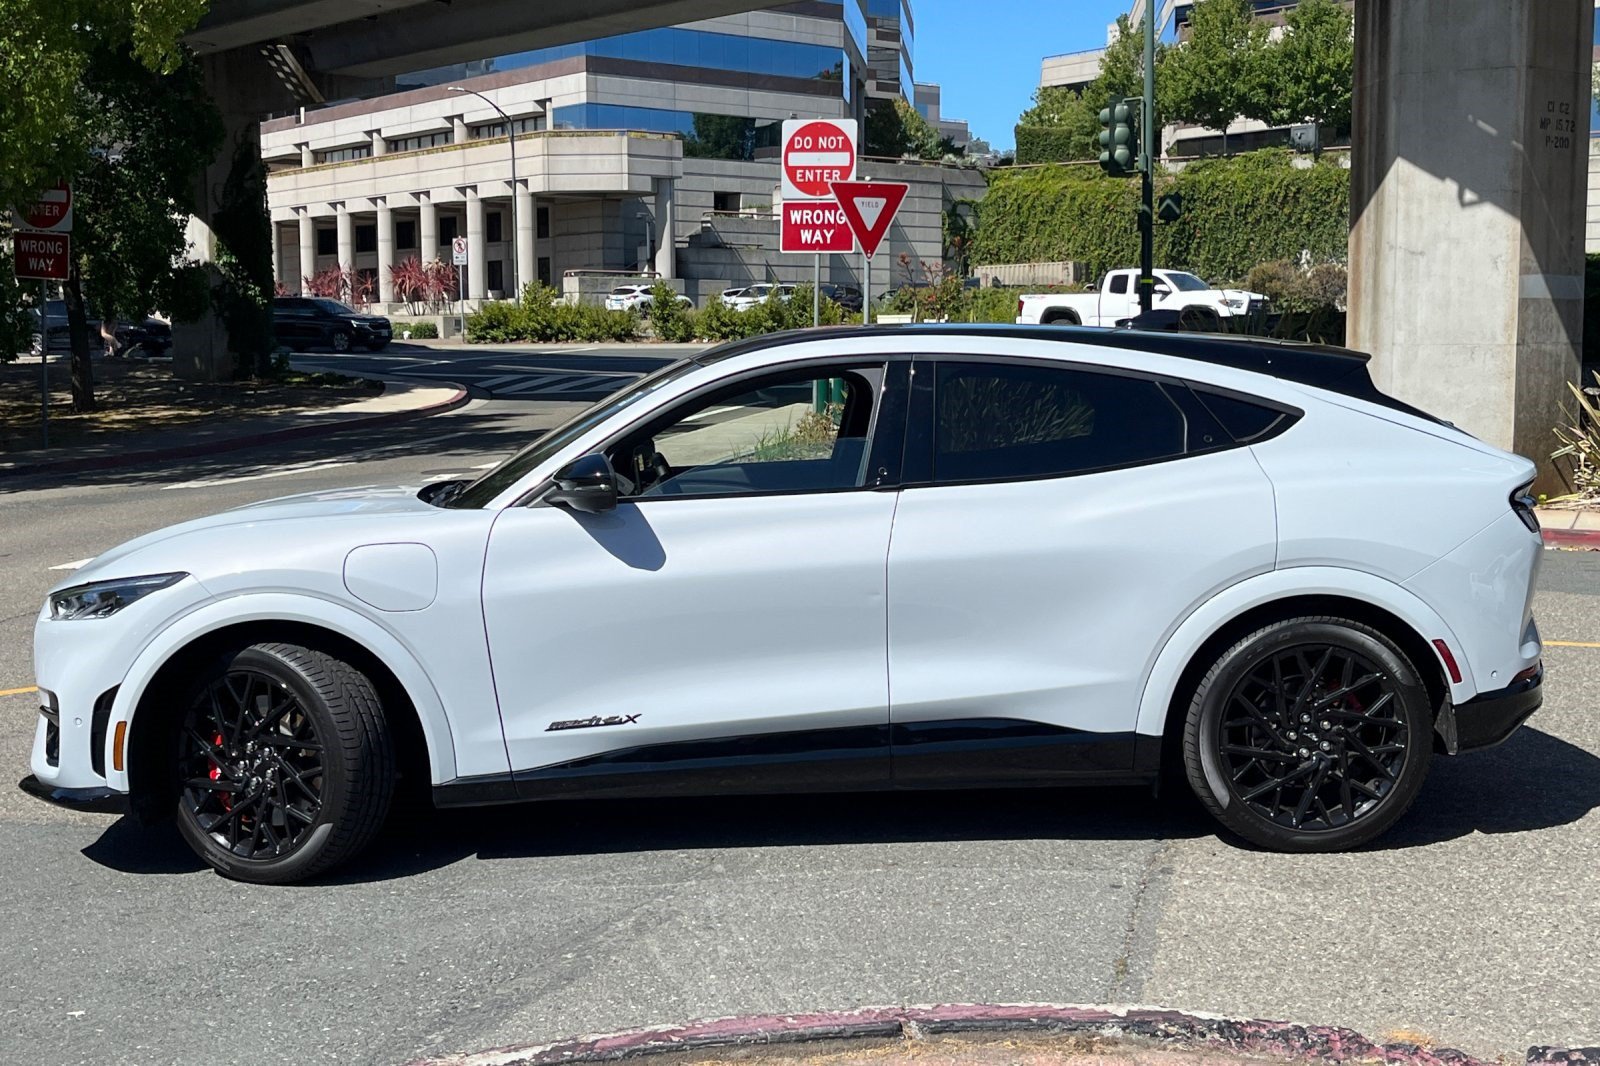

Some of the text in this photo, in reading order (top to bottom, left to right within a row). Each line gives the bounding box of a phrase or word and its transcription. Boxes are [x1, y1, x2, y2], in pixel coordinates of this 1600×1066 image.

[1559, 102, 1570, 115] C2
[1539, 117, 1551, 130] MP
[794, 136, 844, 149] DO NOT
[1545, 135, 1570, 149] P-200
[796, 169, 841, 182] ENTER
[790, 209, 846, 225] WRONG
[800, 229, 835, 244] WAY
[20, 239, 63, 255] WRONG
[28, 257, 55, 272] WAY
